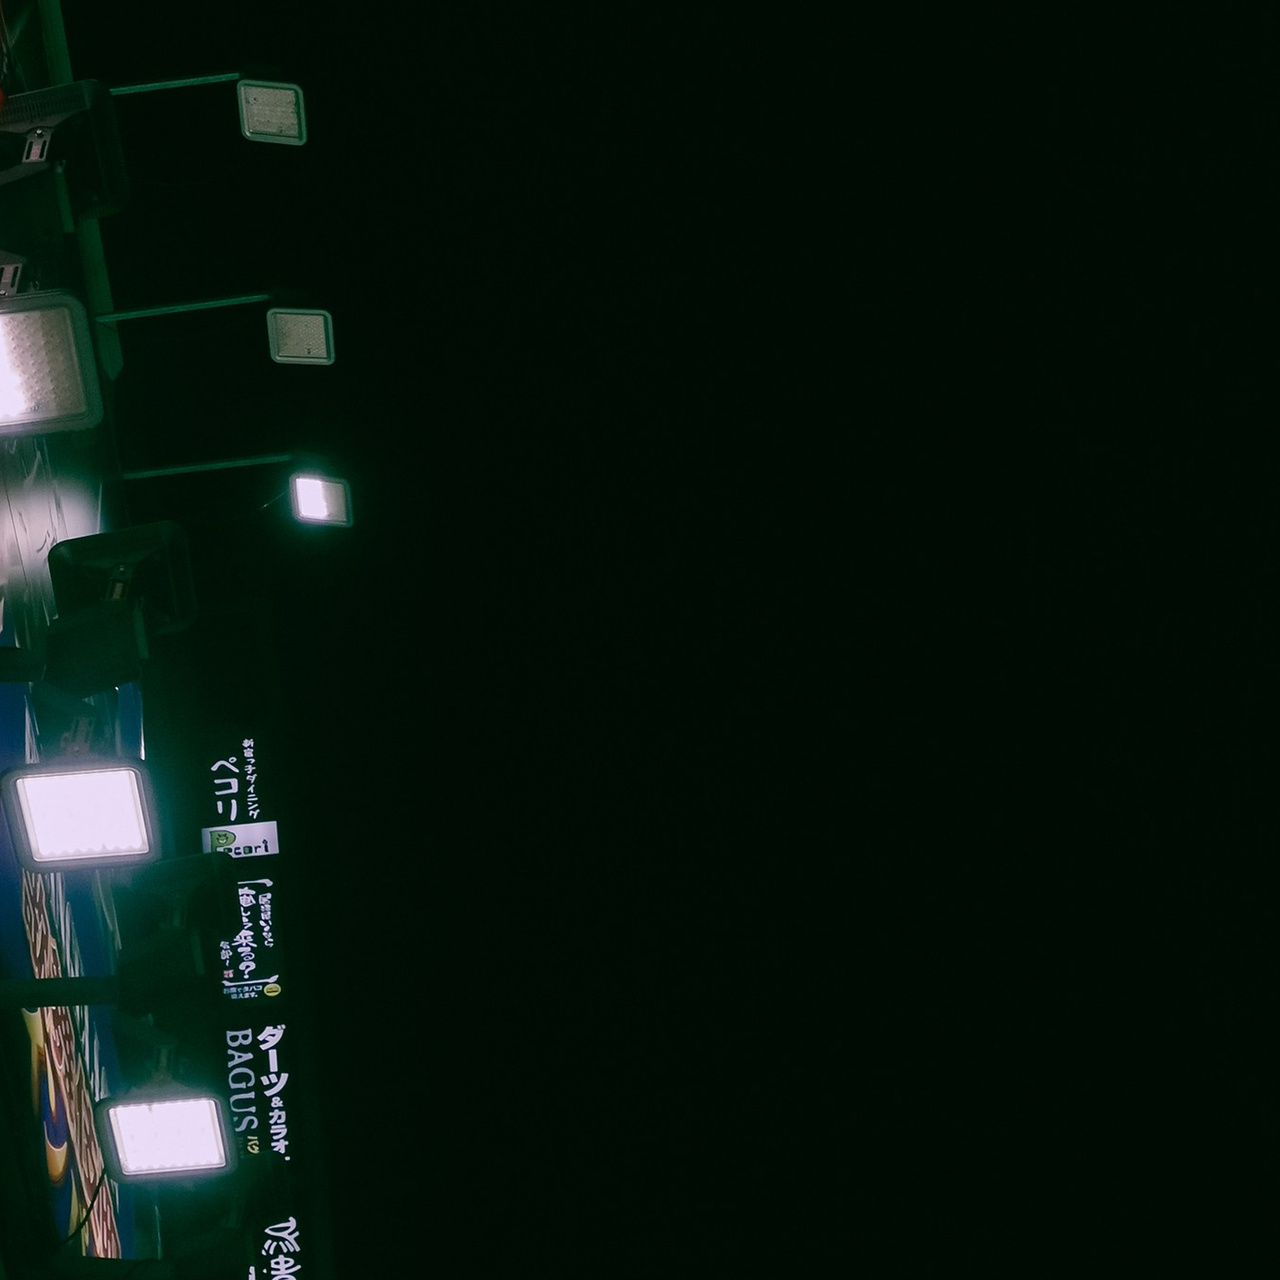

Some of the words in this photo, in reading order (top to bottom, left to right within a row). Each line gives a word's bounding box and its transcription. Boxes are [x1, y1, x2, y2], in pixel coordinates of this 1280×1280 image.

[210, 756, 239, 821] ペコリ
[226, 1028, 259, 1132] BAGUS
[256, 1024, 291, 1161] ダーツ&カラオ
